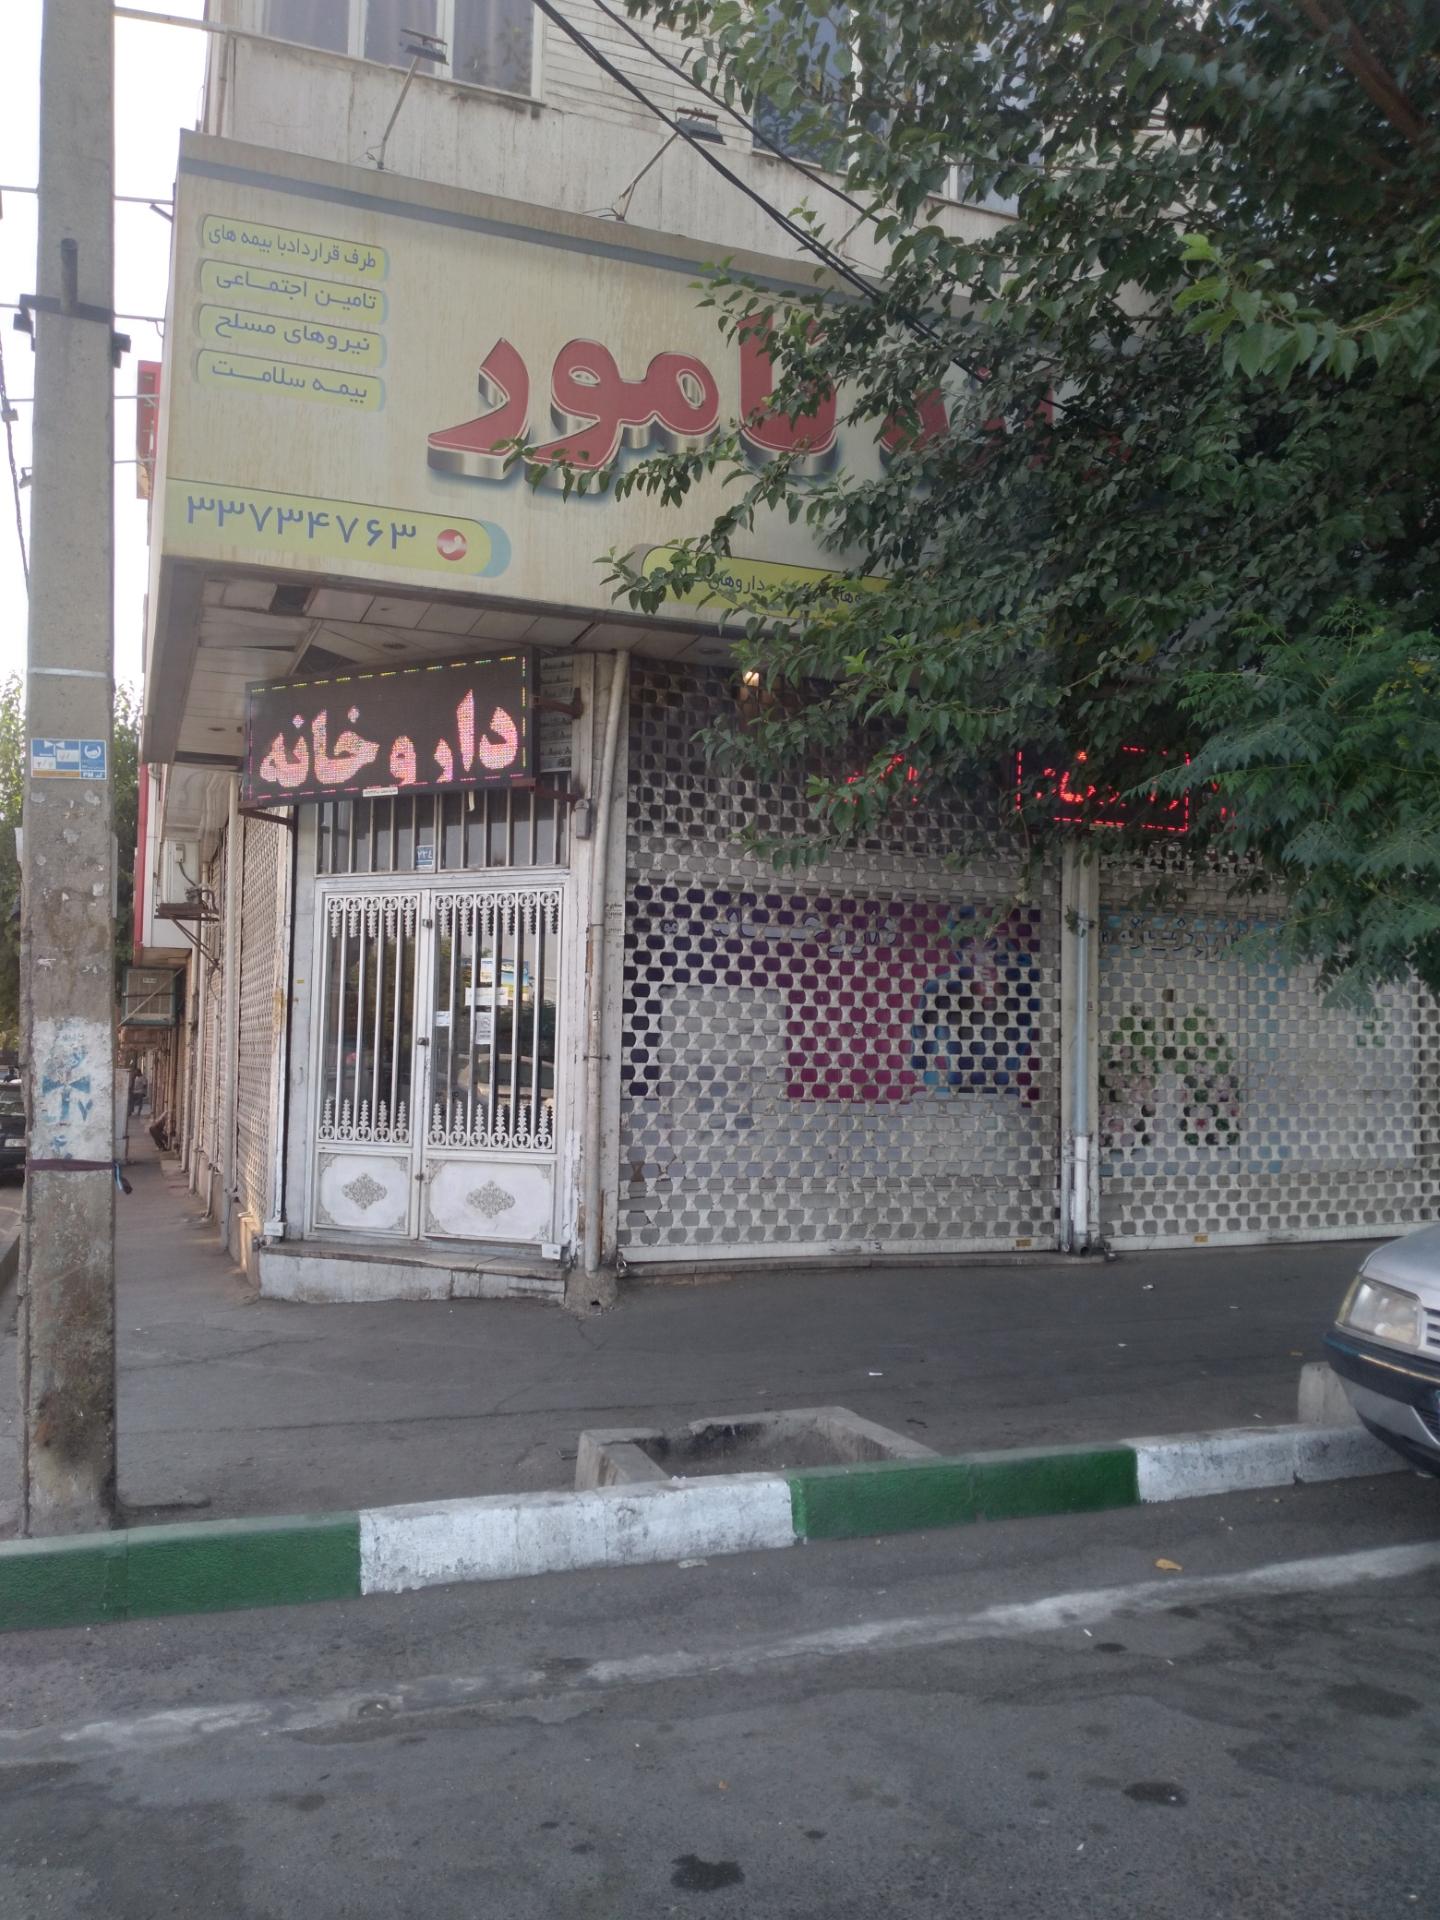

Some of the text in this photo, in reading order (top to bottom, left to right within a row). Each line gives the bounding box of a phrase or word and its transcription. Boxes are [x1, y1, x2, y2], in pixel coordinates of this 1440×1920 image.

[208, 224, 237, 245] های
[240, 231, 273, 254] بیمه
[344, 247, 377, 272] طرف
[216, 271, 377, 311] تامین اجتماعی
[215, 312, 370, 355] نیروهای مسلح
[211, 359, 368, 404] بیمه سلامت
[186, 494, 418, 550] ۳۳۷۳۴۷۶۳
[259, 688, 519, 789] داروخانه
